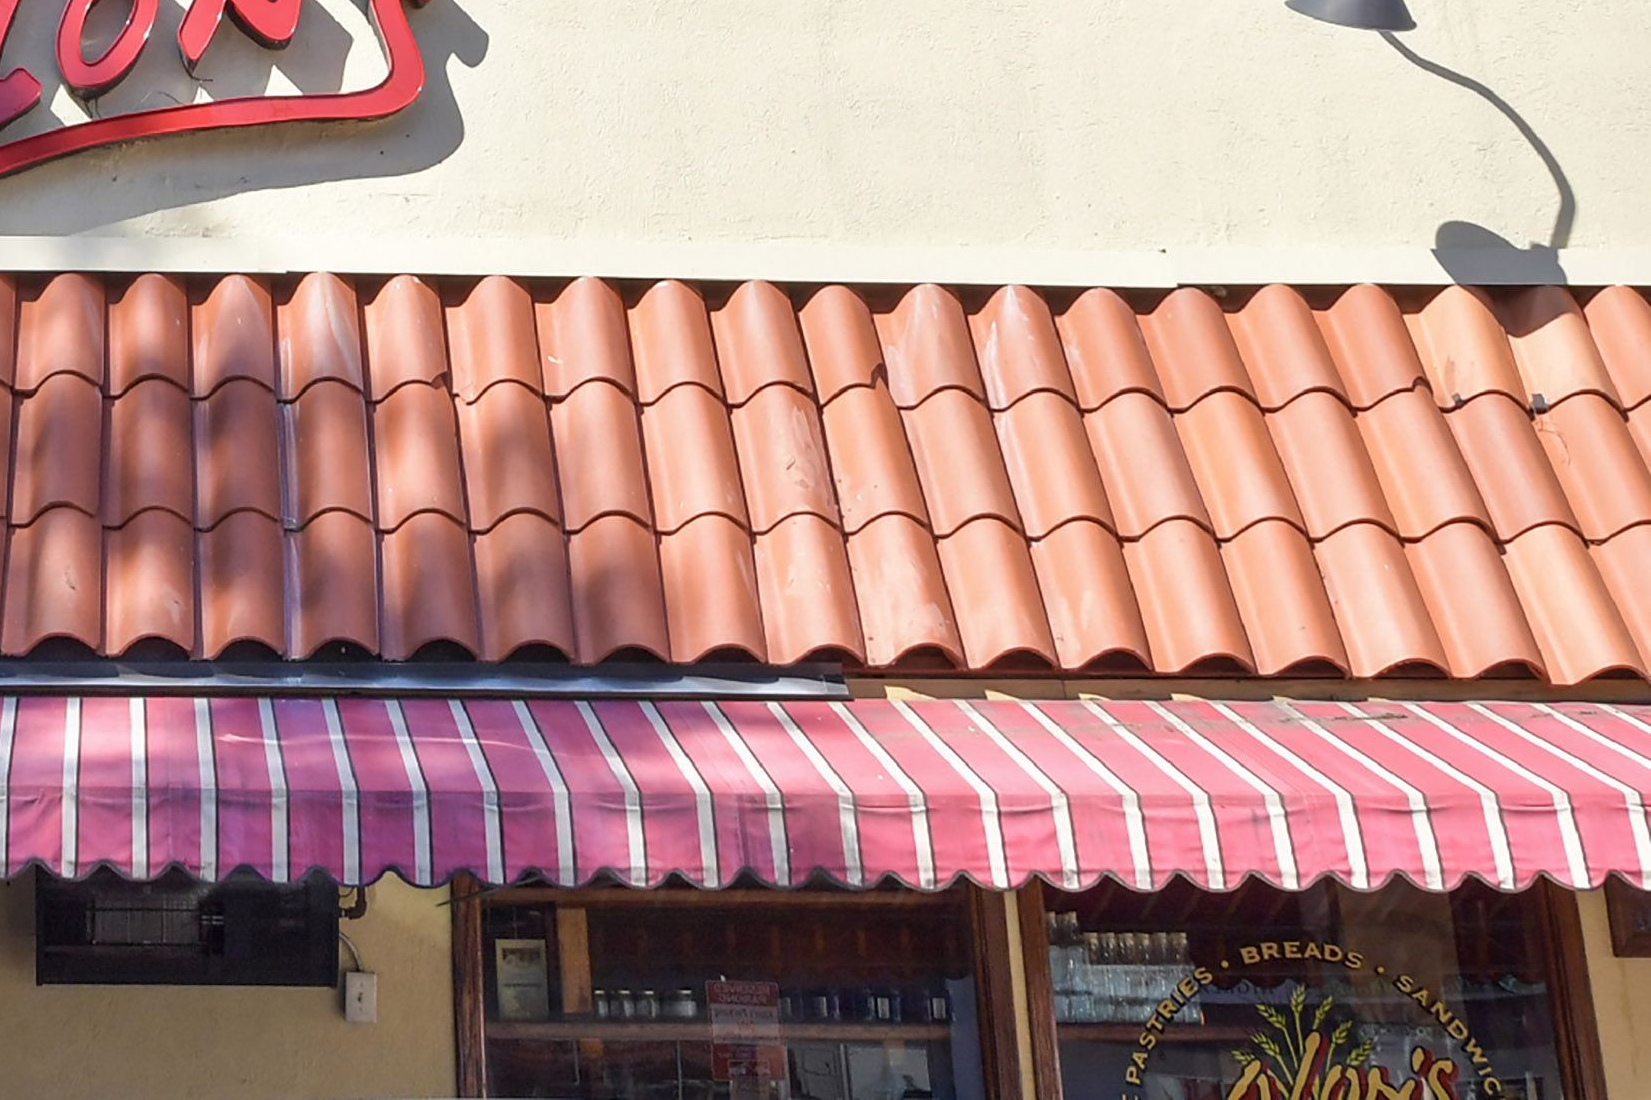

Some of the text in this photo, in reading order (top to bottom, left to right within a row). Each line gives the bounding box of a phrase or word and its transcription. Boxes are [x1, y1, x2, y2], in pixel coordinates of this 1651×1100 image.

[1126, 941, 1507, 1100] PASTRIES BREADS SANDWIC
